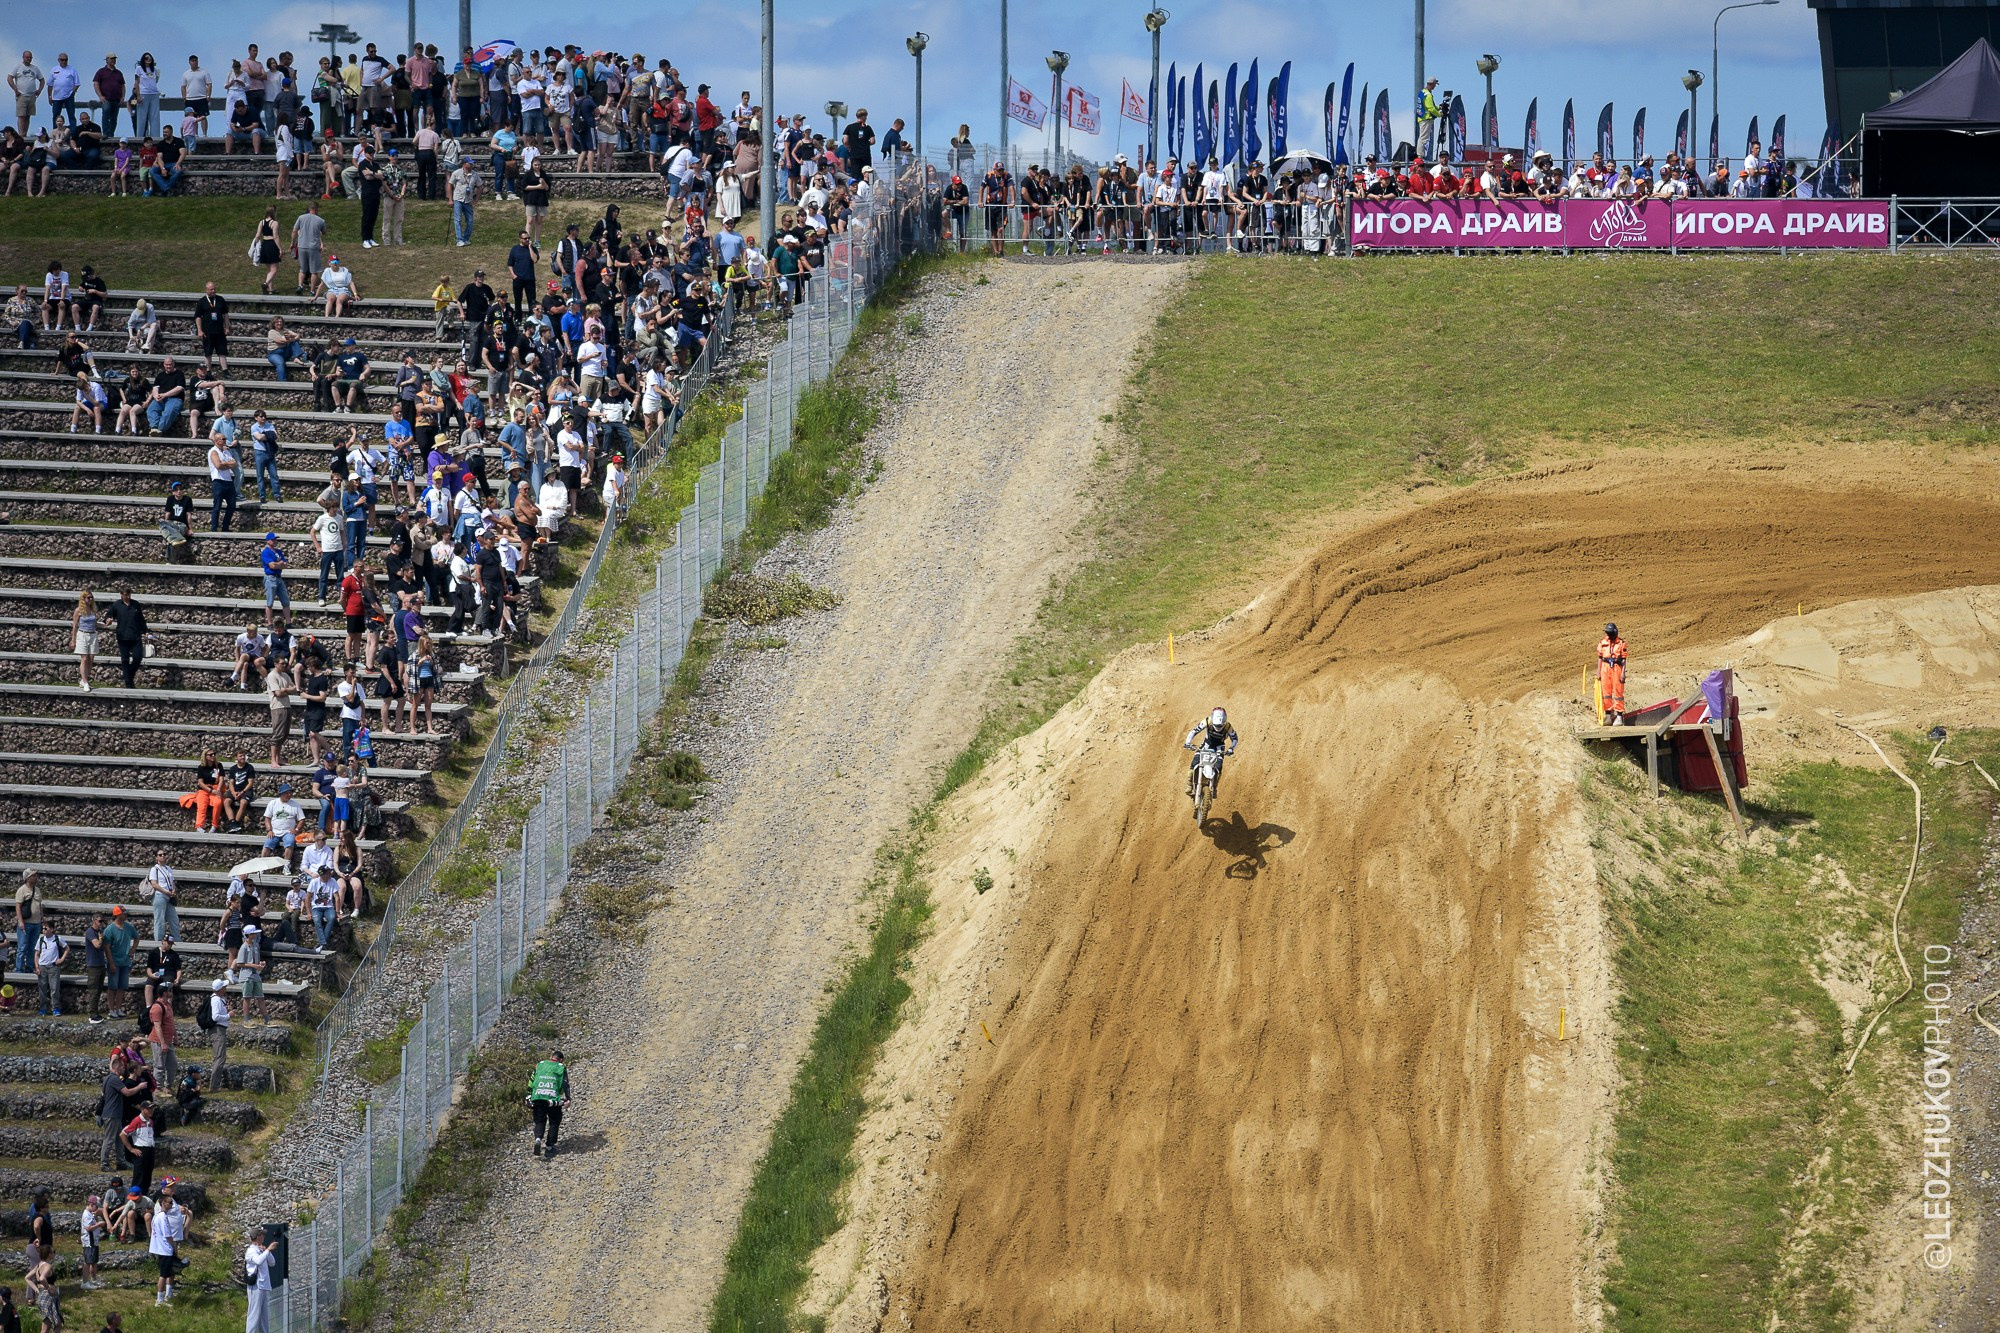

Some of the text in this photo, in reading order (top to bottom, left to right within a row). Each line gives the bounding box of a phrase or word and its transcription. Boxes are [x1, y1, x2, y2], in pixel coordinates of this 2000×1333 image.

[1354, 212, 1562, 235] ИГОРА ДРАЙВ
[1675, 212, 1885, 235] ИГОРА ДРАЙВ
